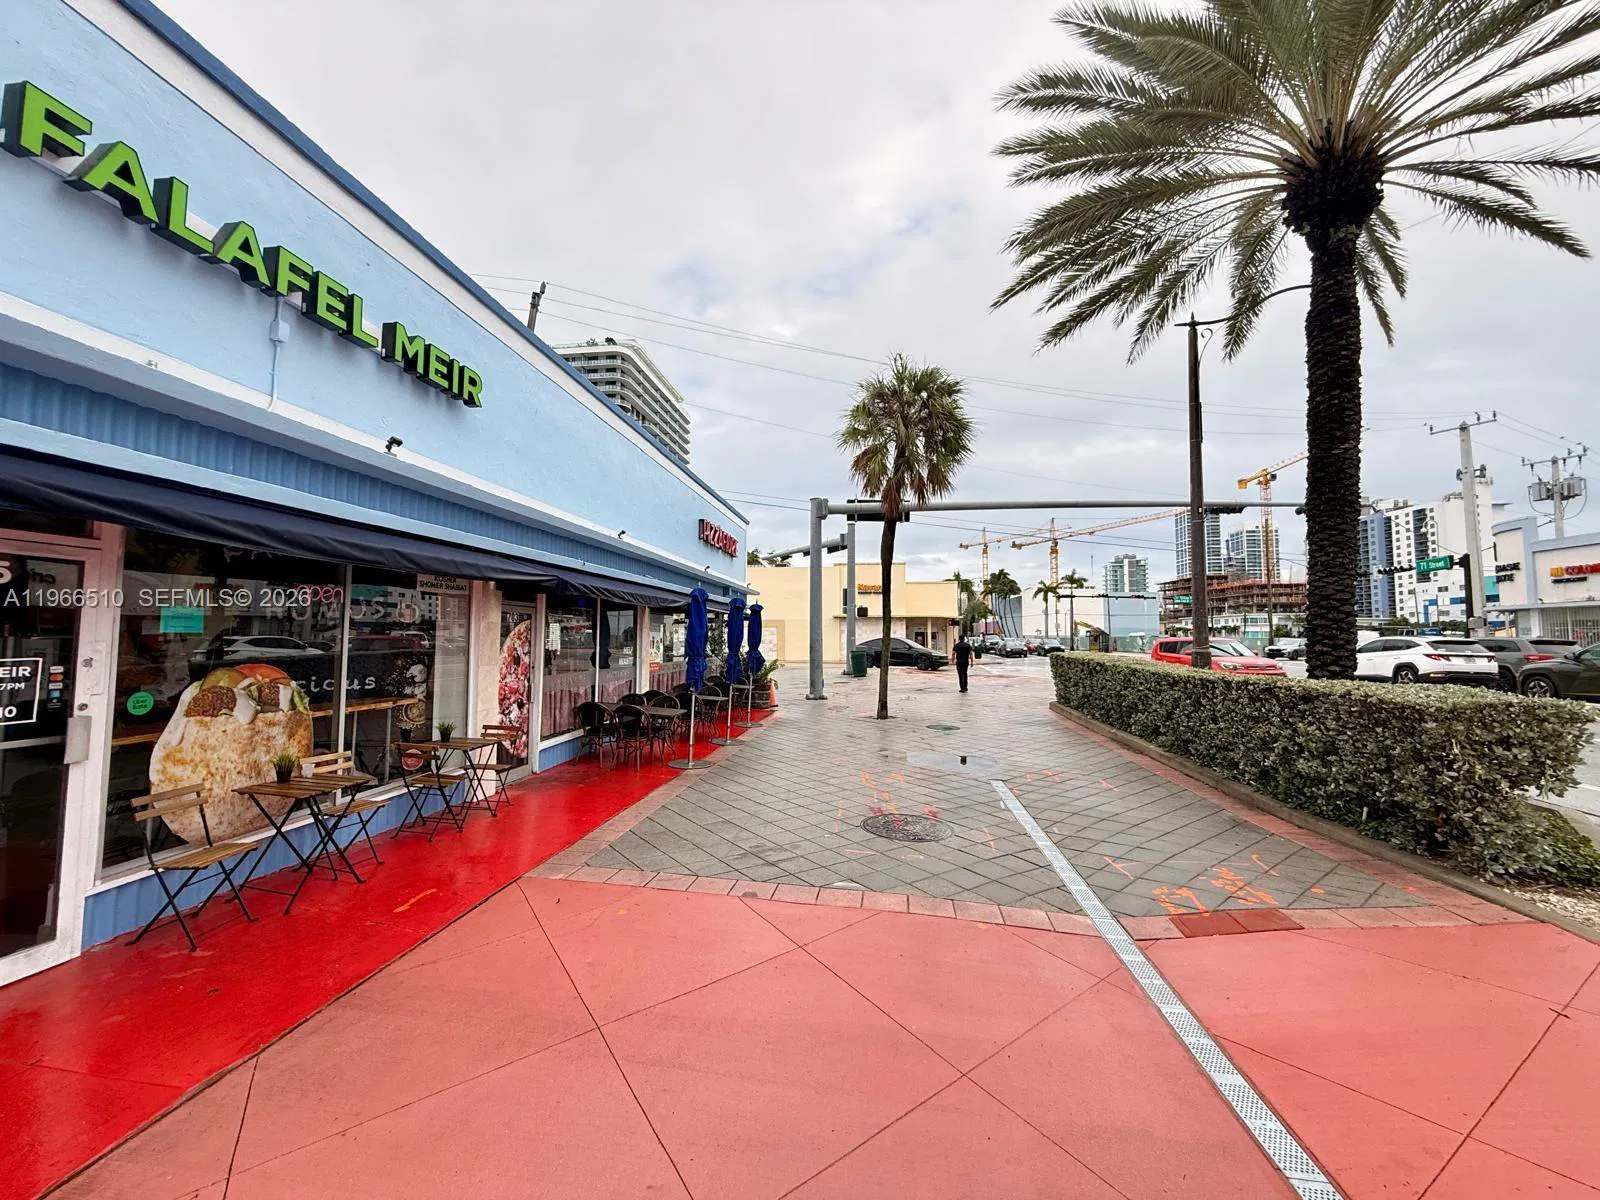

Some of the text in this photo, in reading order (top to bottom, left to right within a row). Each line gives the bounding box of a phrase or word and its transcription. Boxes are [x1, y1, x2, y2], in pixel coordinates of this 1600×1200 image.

[3, 80, 483, 408] FALAFEL MEIR
[1429, 560, 1445, 568] Street
